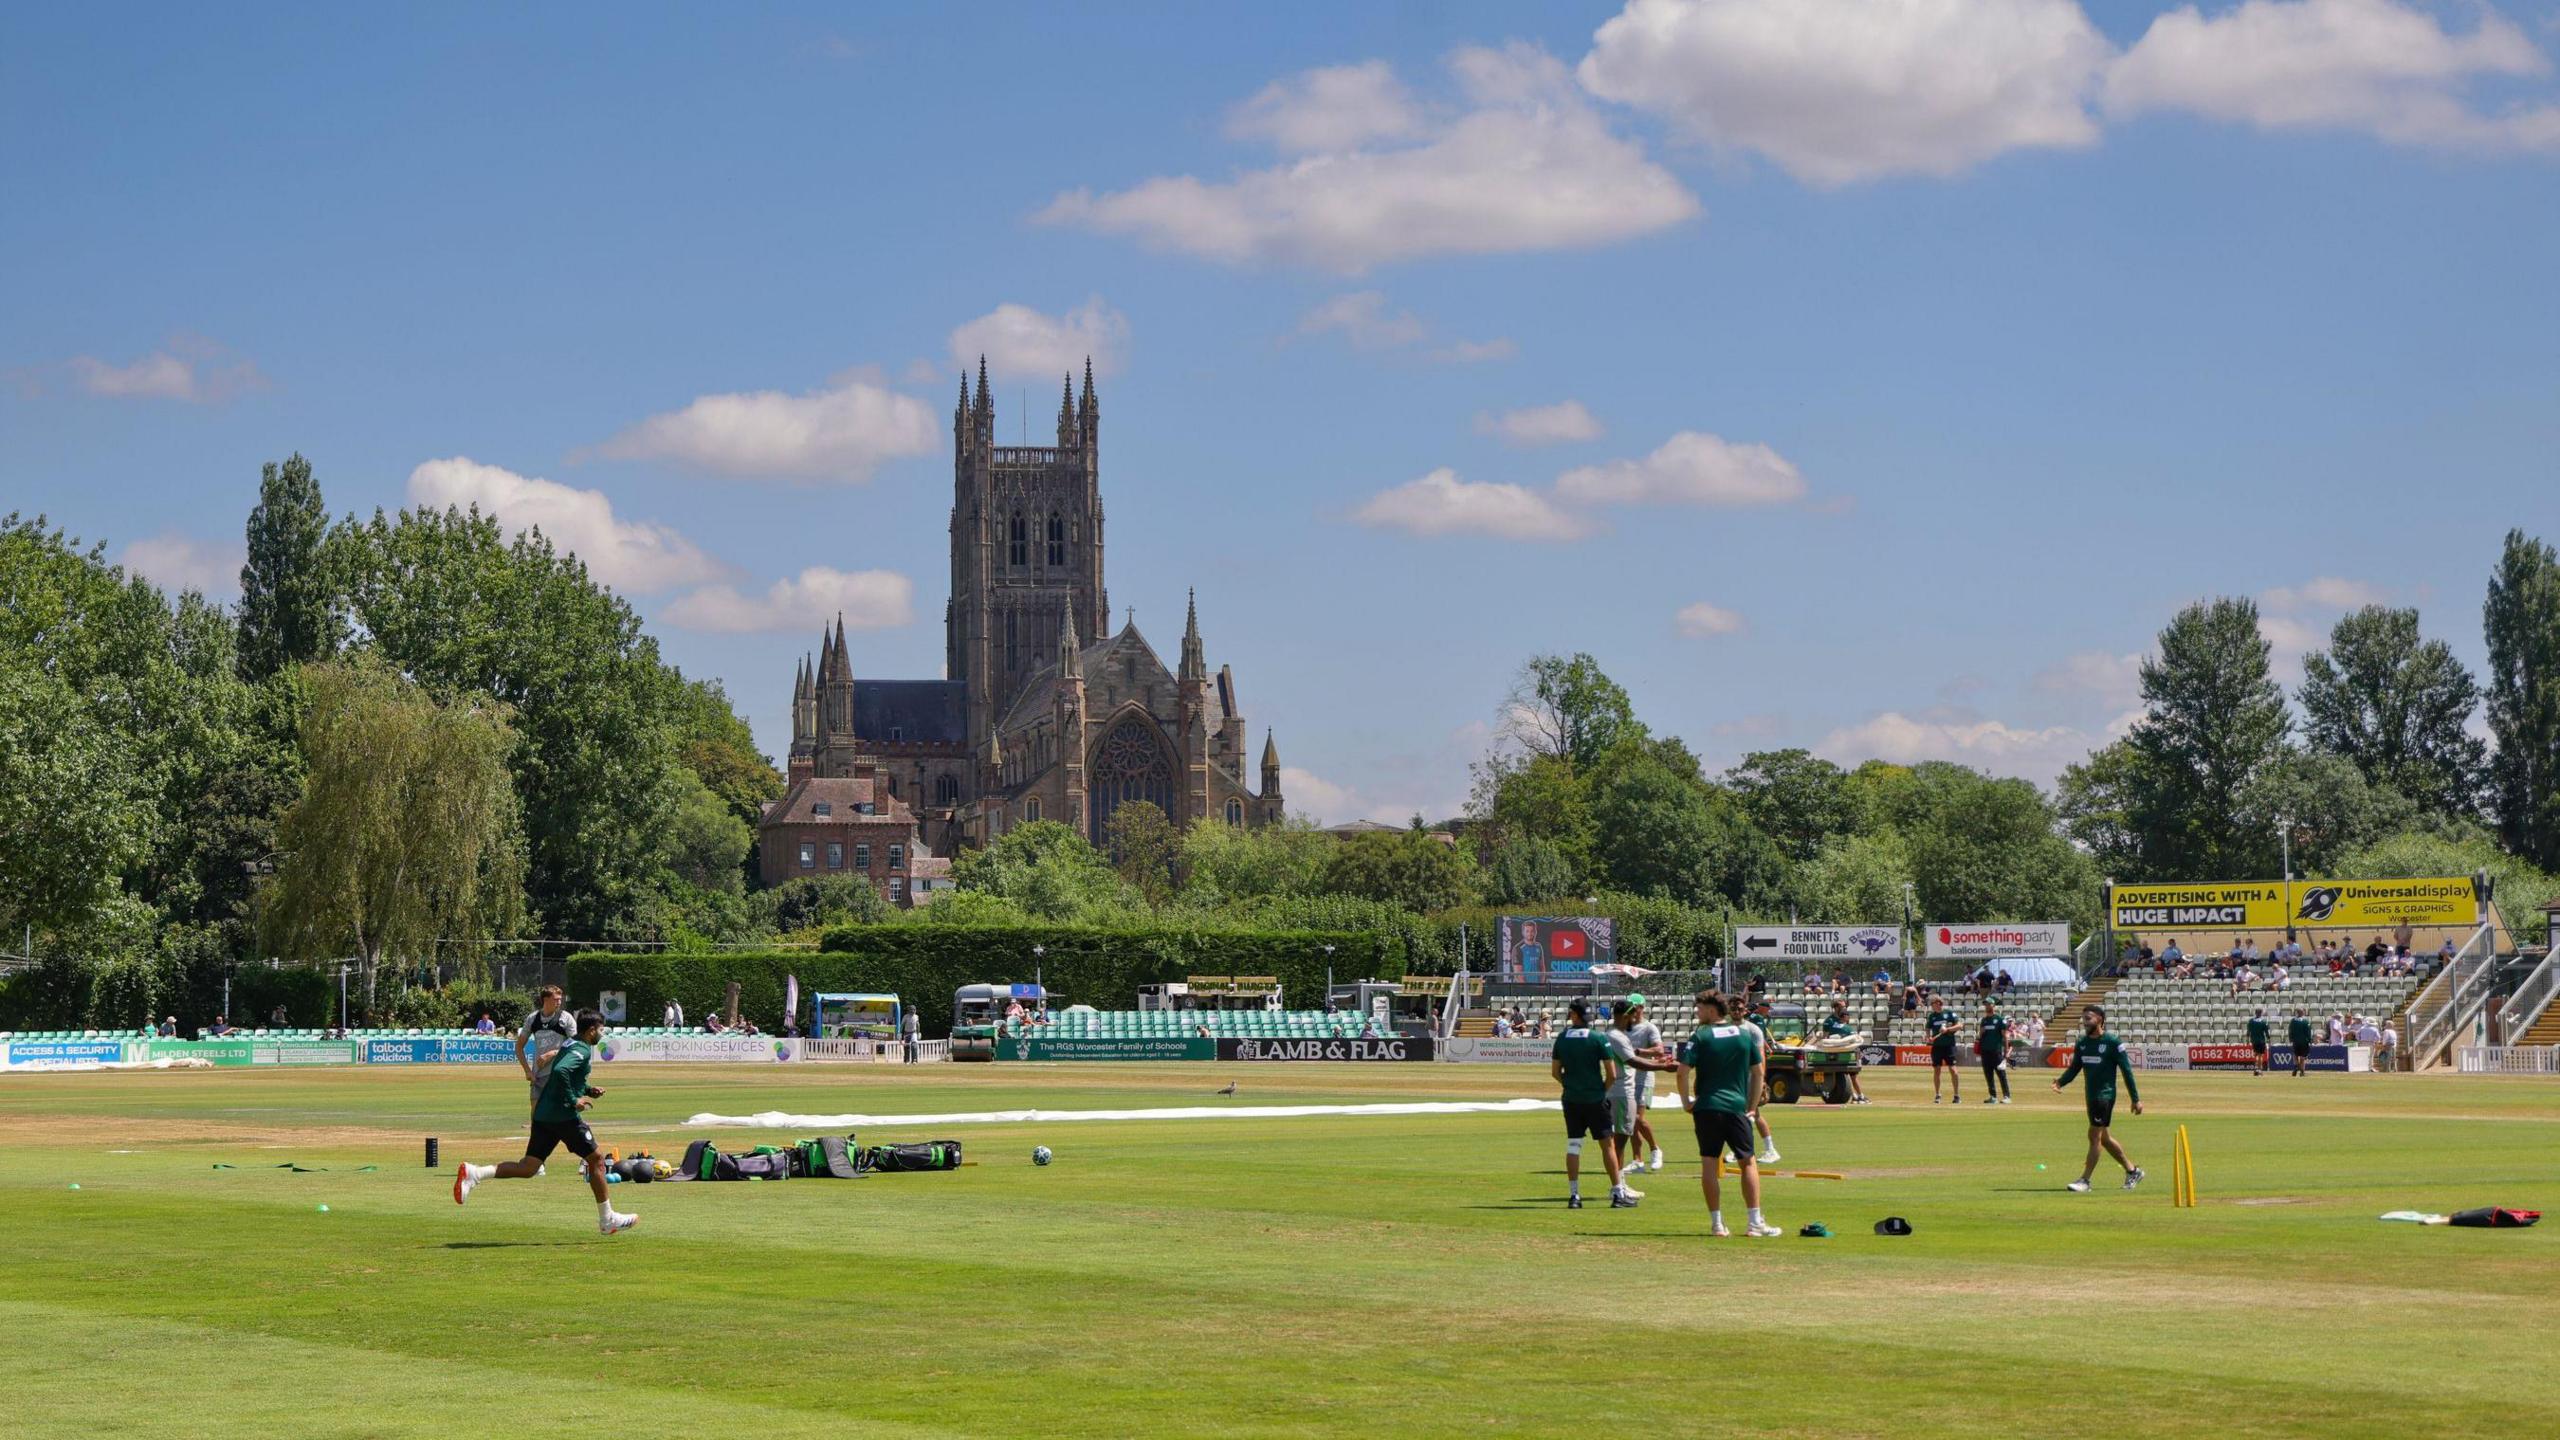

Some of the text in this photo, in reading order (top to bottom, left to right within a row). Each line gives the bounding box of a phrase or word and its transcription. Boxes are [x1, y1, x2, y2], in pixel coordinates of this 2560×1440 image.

[2117, 890, 2277, 904] ADVERTISING WITH A
[2346, 885, 2470, 900] Universaldisplay
[2362, 904, 2454, 914] SIGNS & GRAPHICS
[2118, 907, 2244, 924] HUGE IMPACT
[1791, 931, 1840, 942] BENNETTS
[1849, 929, 1897, 945] BENNETTS
[1953, 929, 2055, 946] somethingparty
[1784, 943, 1848, 955] FOOD VILLAGE
[1951, 946, 1988, 955] balloons
[1998, 946, 2022, 954] more
[1404, 982, 1425, 990] THE
[372, 1042, 412, 1053] talbots
[484, 1041, 507, 1050] FOR
[1040, 1042, 1187, 1051] The RGS Worcester Family of Schools
[1256, 1041, 1406, 1060] LAMB & FLAG
[12, 1046, 118, 1056] ACCESS & SECURITY
[152, 1050, 189, 1058] MILDEN
[192, 1050, 226, 1058] STEELS
[228, 1049, 246, 1058] LTD
[2191, 1050, 2223, 1059] 01562
[372, 1053, 413, 1062] solicitors
[2146, 1056, 2184, 1064] Ventilation
